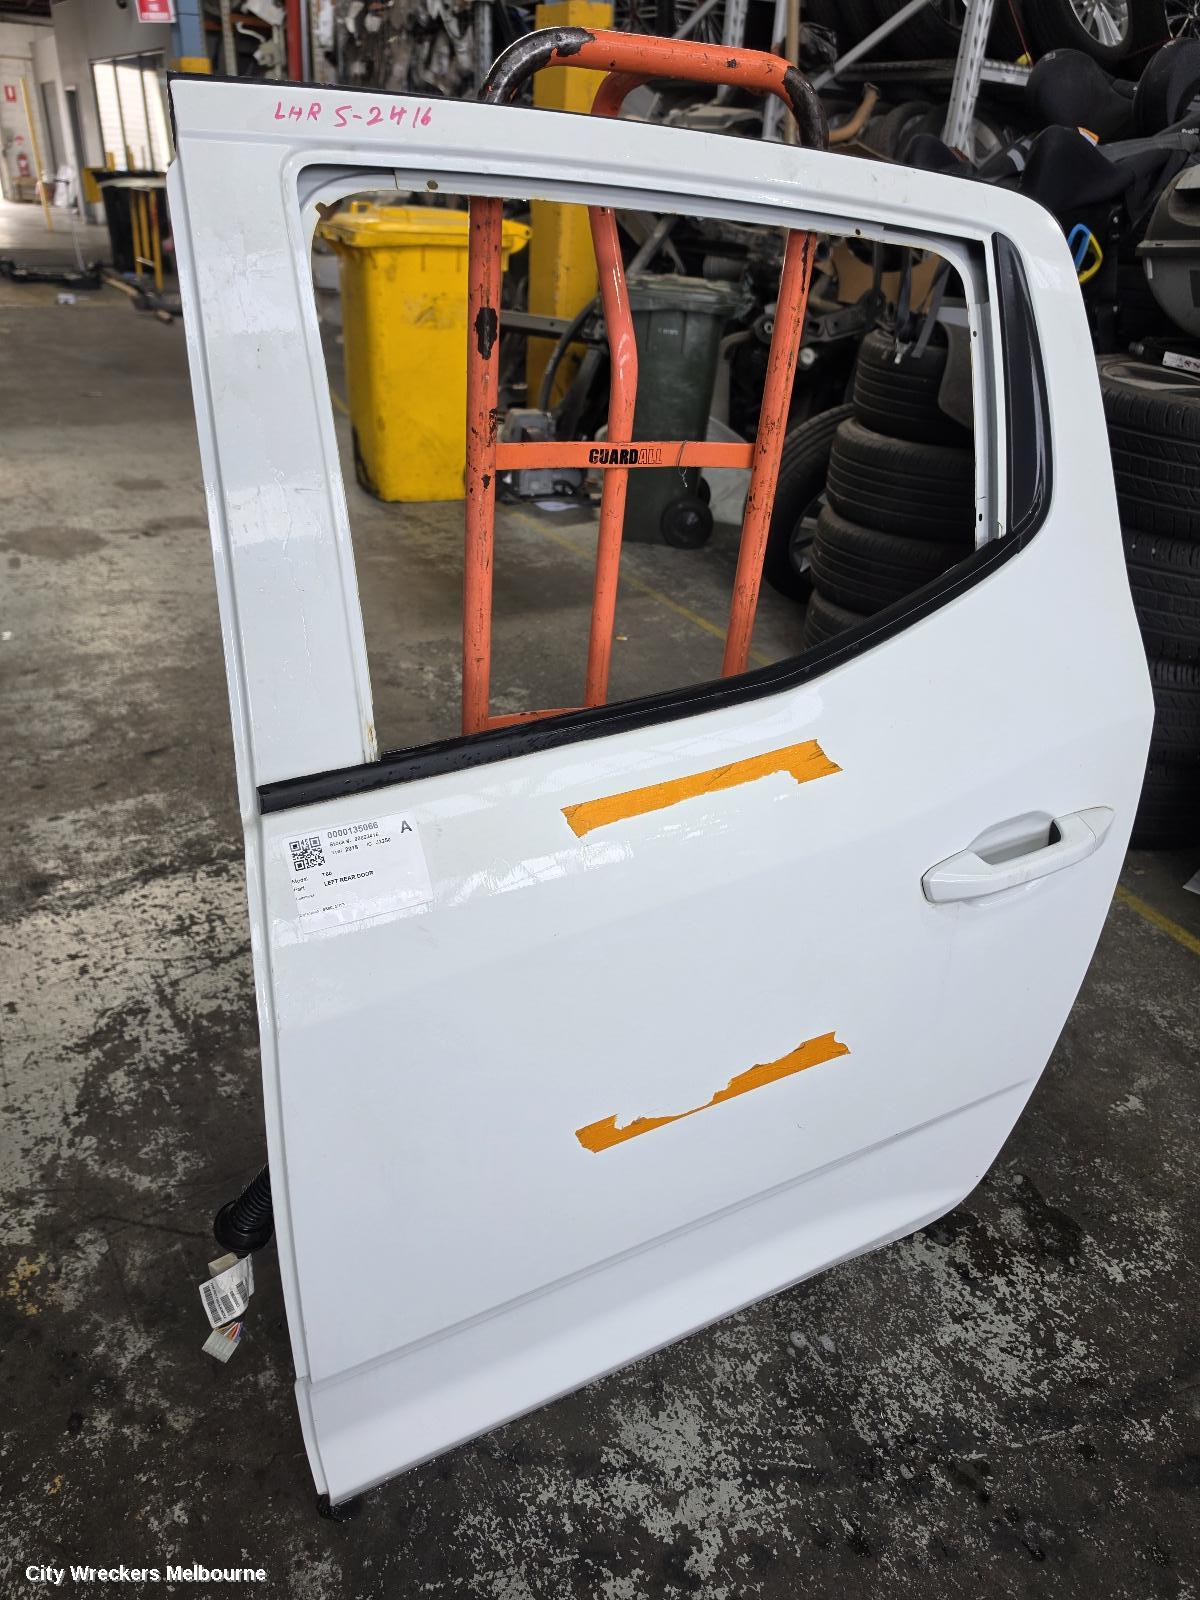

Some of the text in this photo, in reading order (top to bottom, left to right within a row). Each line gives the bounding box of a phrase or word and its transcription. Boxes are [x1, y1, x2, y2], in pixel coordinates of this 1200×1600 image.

[274, 101, 322, 121] LHR
[588, 448, 662, 465] GUARDALL
[400, 820, 413, 834] A
[323, 870, 374, 887] LEFT REAR DOOR
